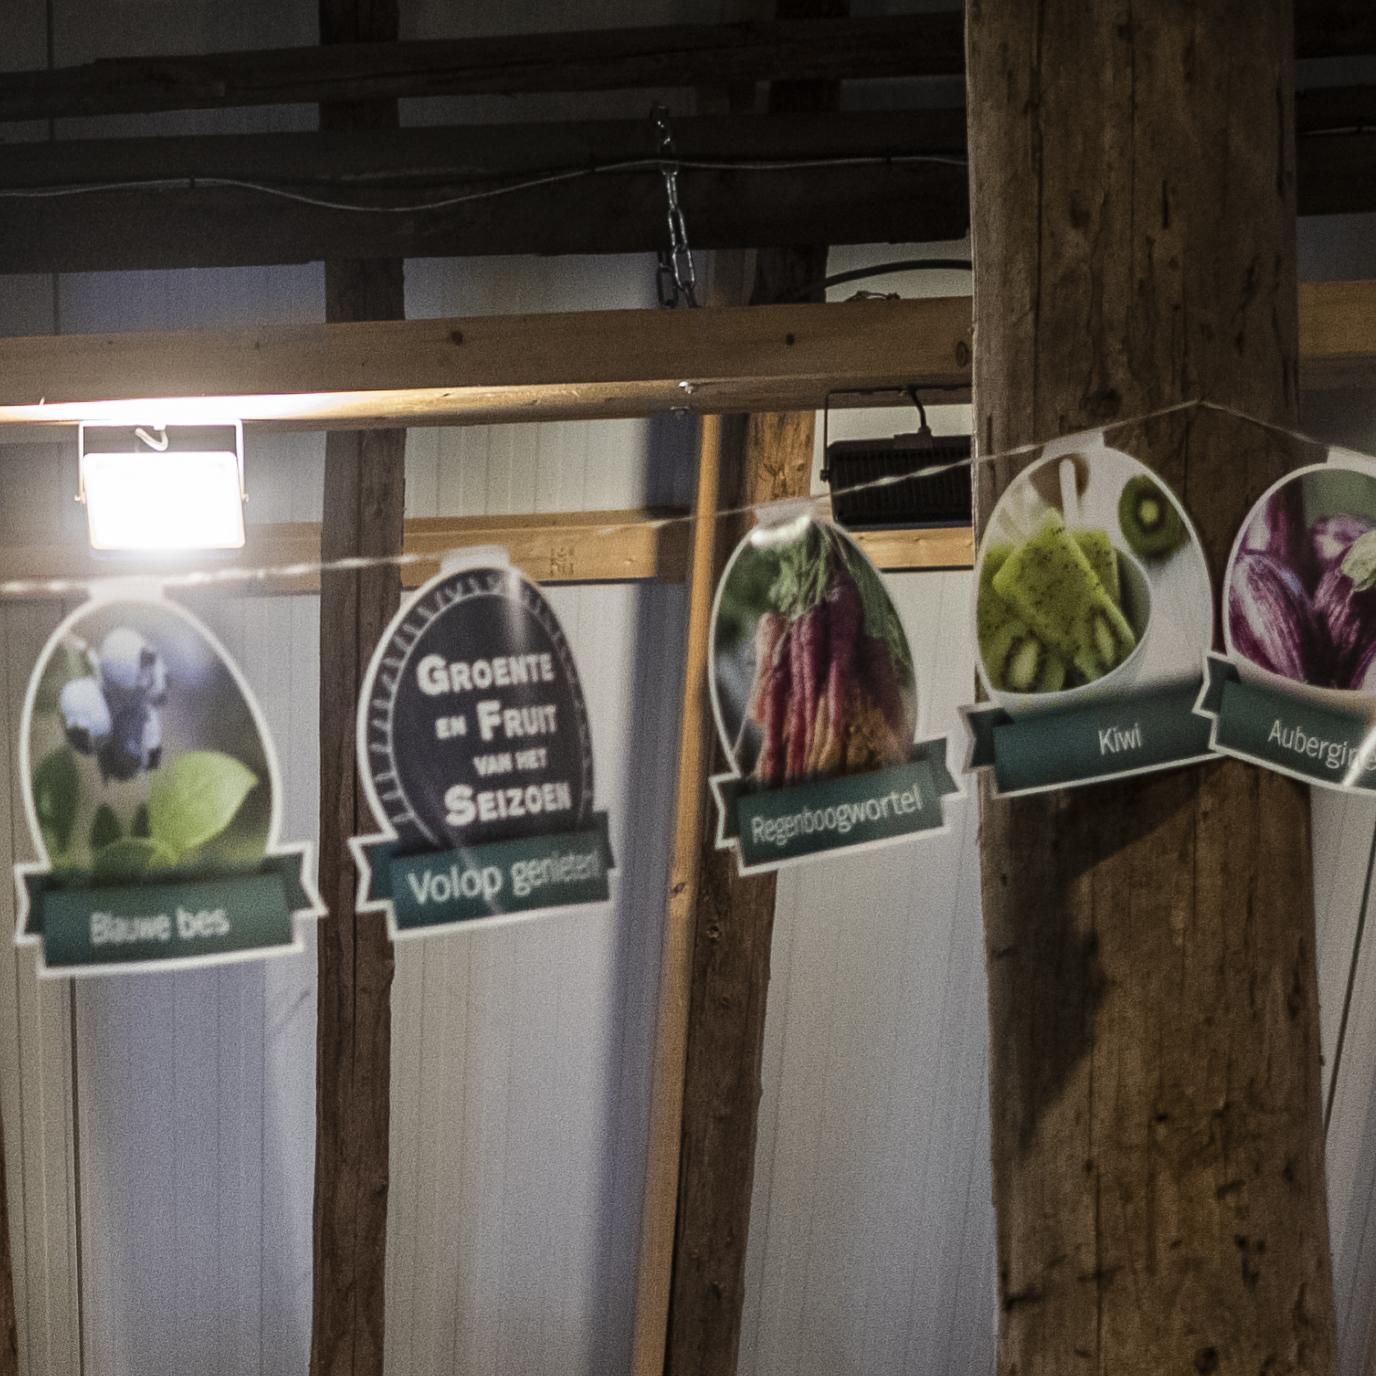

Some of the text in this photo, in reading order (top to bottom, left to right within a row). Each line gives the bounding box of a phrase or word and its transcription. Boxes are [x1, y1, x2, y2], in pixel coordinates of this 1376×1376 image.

[1098, 722, 1143, 756] Kiwi
[750, 784, 924, 847] Regenboogwortel
[407, 862, 504, 905] Volop
[89, 905, 231, 946] Blauwe bes
